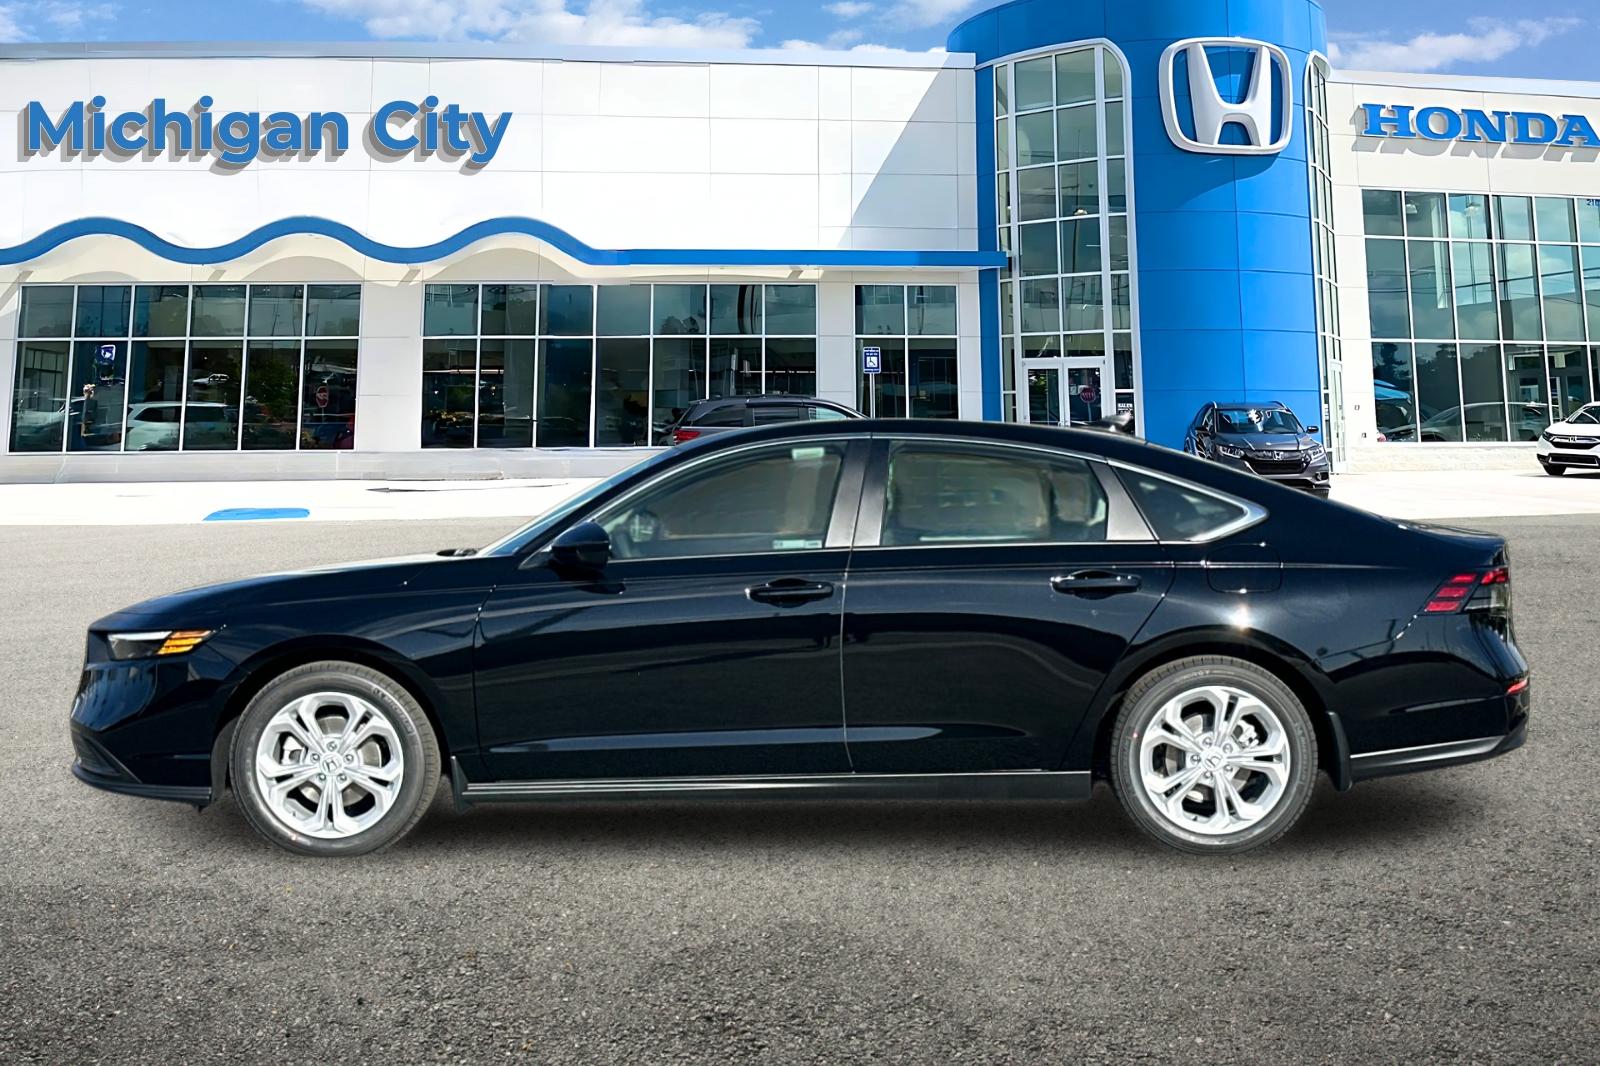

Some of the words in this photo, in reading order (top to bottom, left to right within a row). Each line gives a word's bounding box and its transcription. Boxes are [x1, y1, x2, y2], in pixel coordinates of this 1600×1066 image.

[29, 95, 349, 163] Michigan
[374, 95, 513, 163] City
[1362, 103, 1600, 147] HONDA
